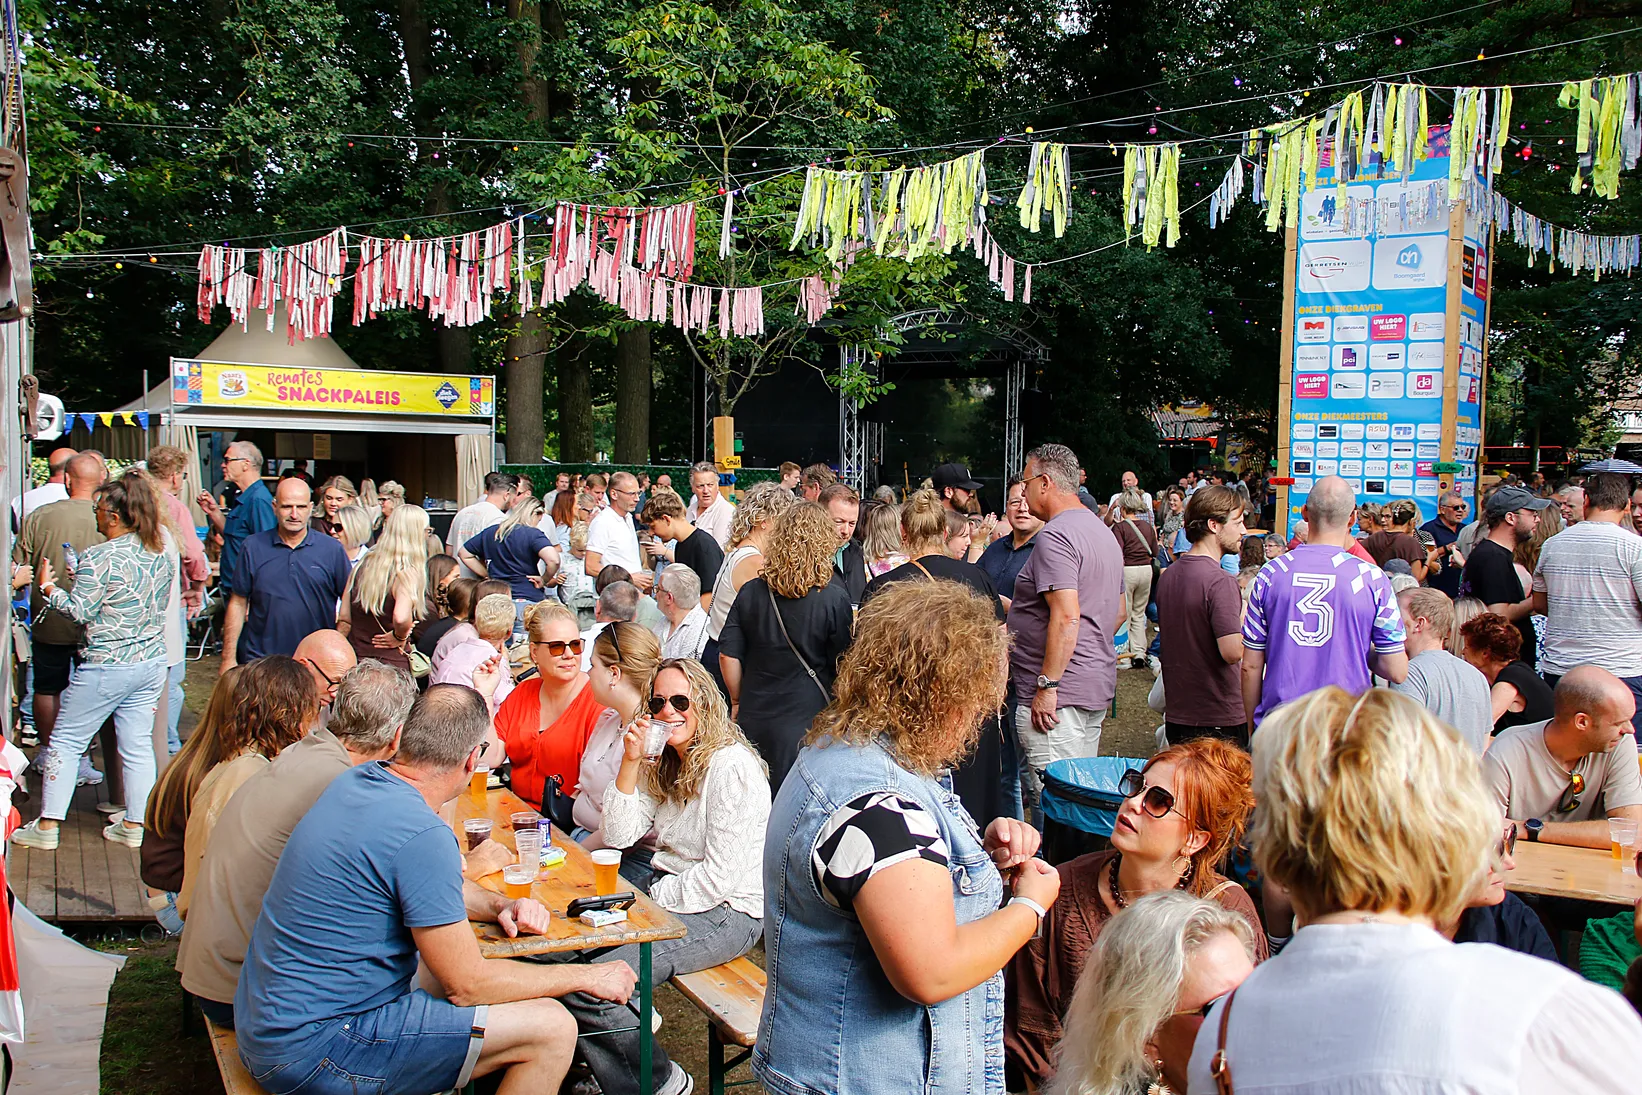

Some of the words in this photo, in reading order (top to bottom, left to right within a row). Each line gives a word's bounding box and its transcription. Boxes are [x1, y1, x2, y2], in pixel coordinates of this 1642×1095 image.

[1298, 306, 1323, 314] ONZE
[1325, 303, 1383, 313] DIEKGRAVEN
[1343, 356, 1355, 364] pci
[267, 368, 323, 387] Renates
[1417, 376, 1431, 388] da
[277, 385, 401, 405] SNACKPALEIS
[1294, 412, 1319, 420] ONZE
[1321, 412, 1388, 420] DIEKMEESTERS
[1287, 572, 1337, 647] 3
